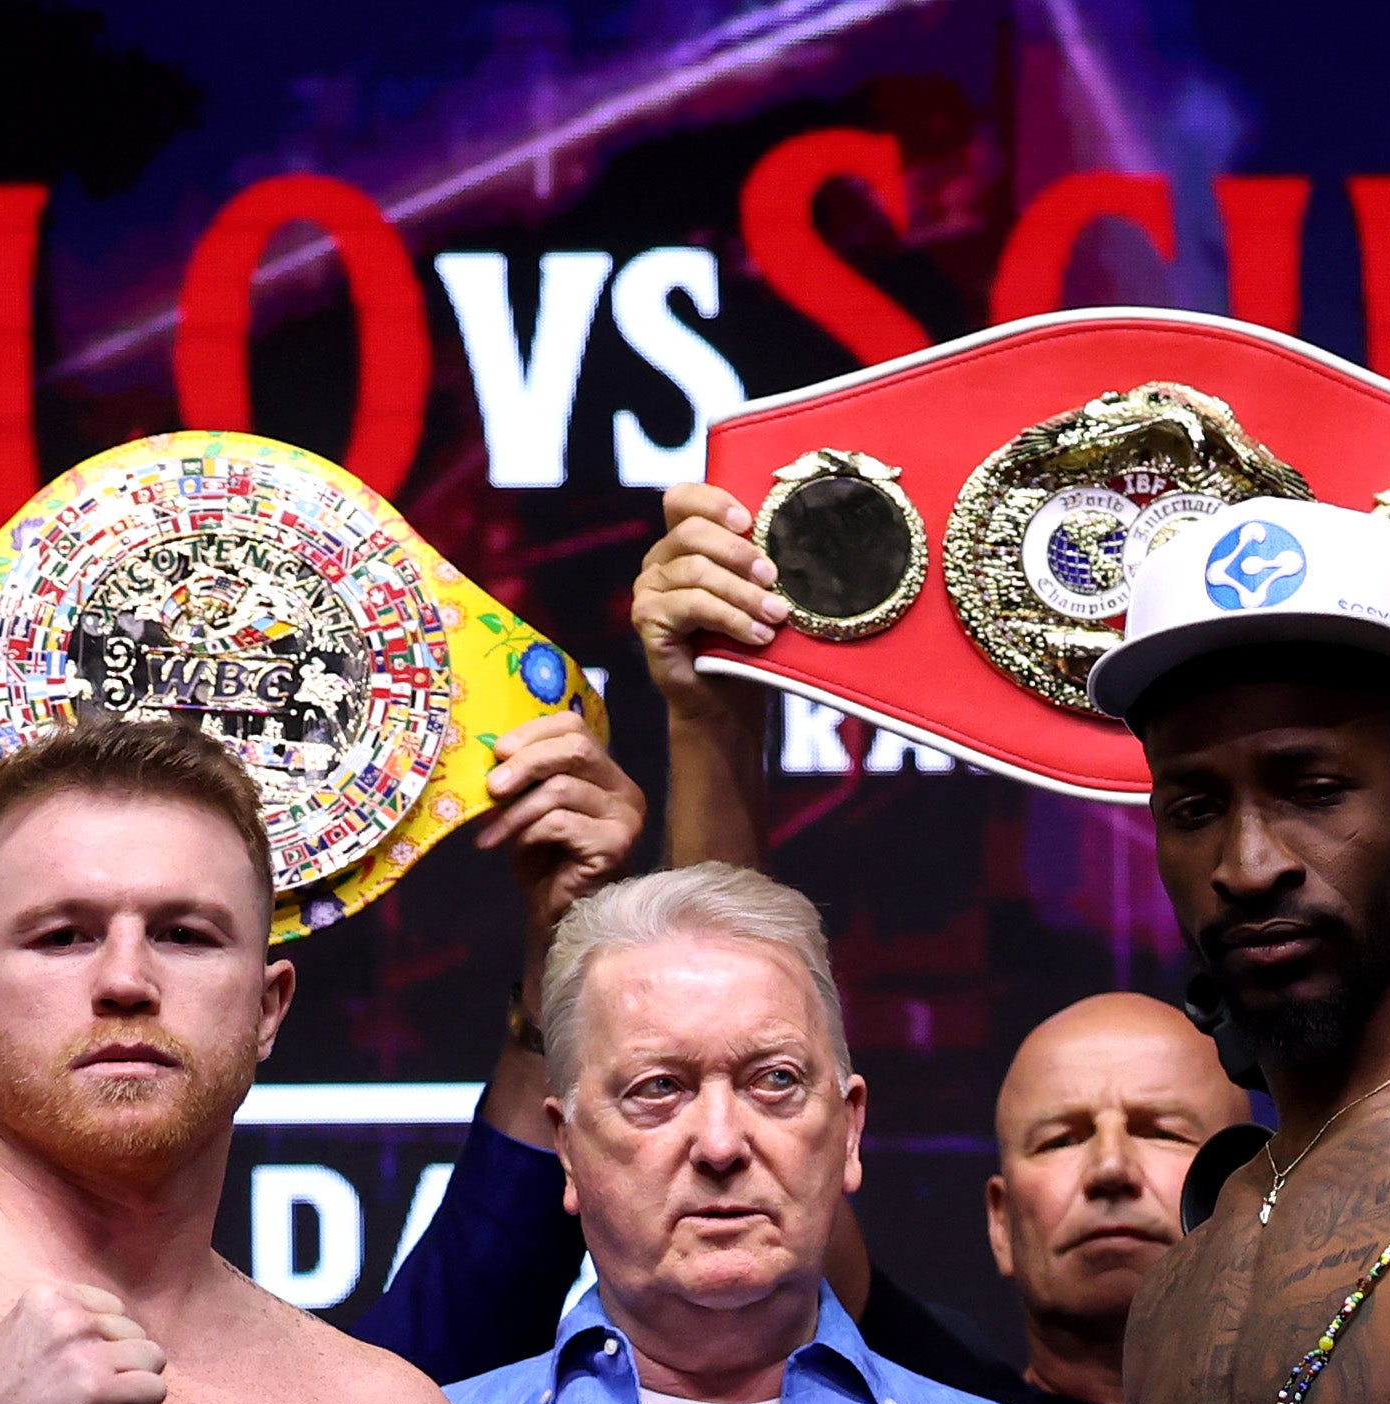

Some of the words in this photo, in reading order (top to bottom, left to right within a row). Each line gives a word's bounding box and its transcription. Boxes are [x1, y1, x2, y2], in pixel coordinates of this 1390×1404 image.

[436, 247, 745, 487] VS
[1123, 473, 1167, 495] IBF
[1134, 498, 1223, 543] Internati
[147, 655, 295, 703] WBC
